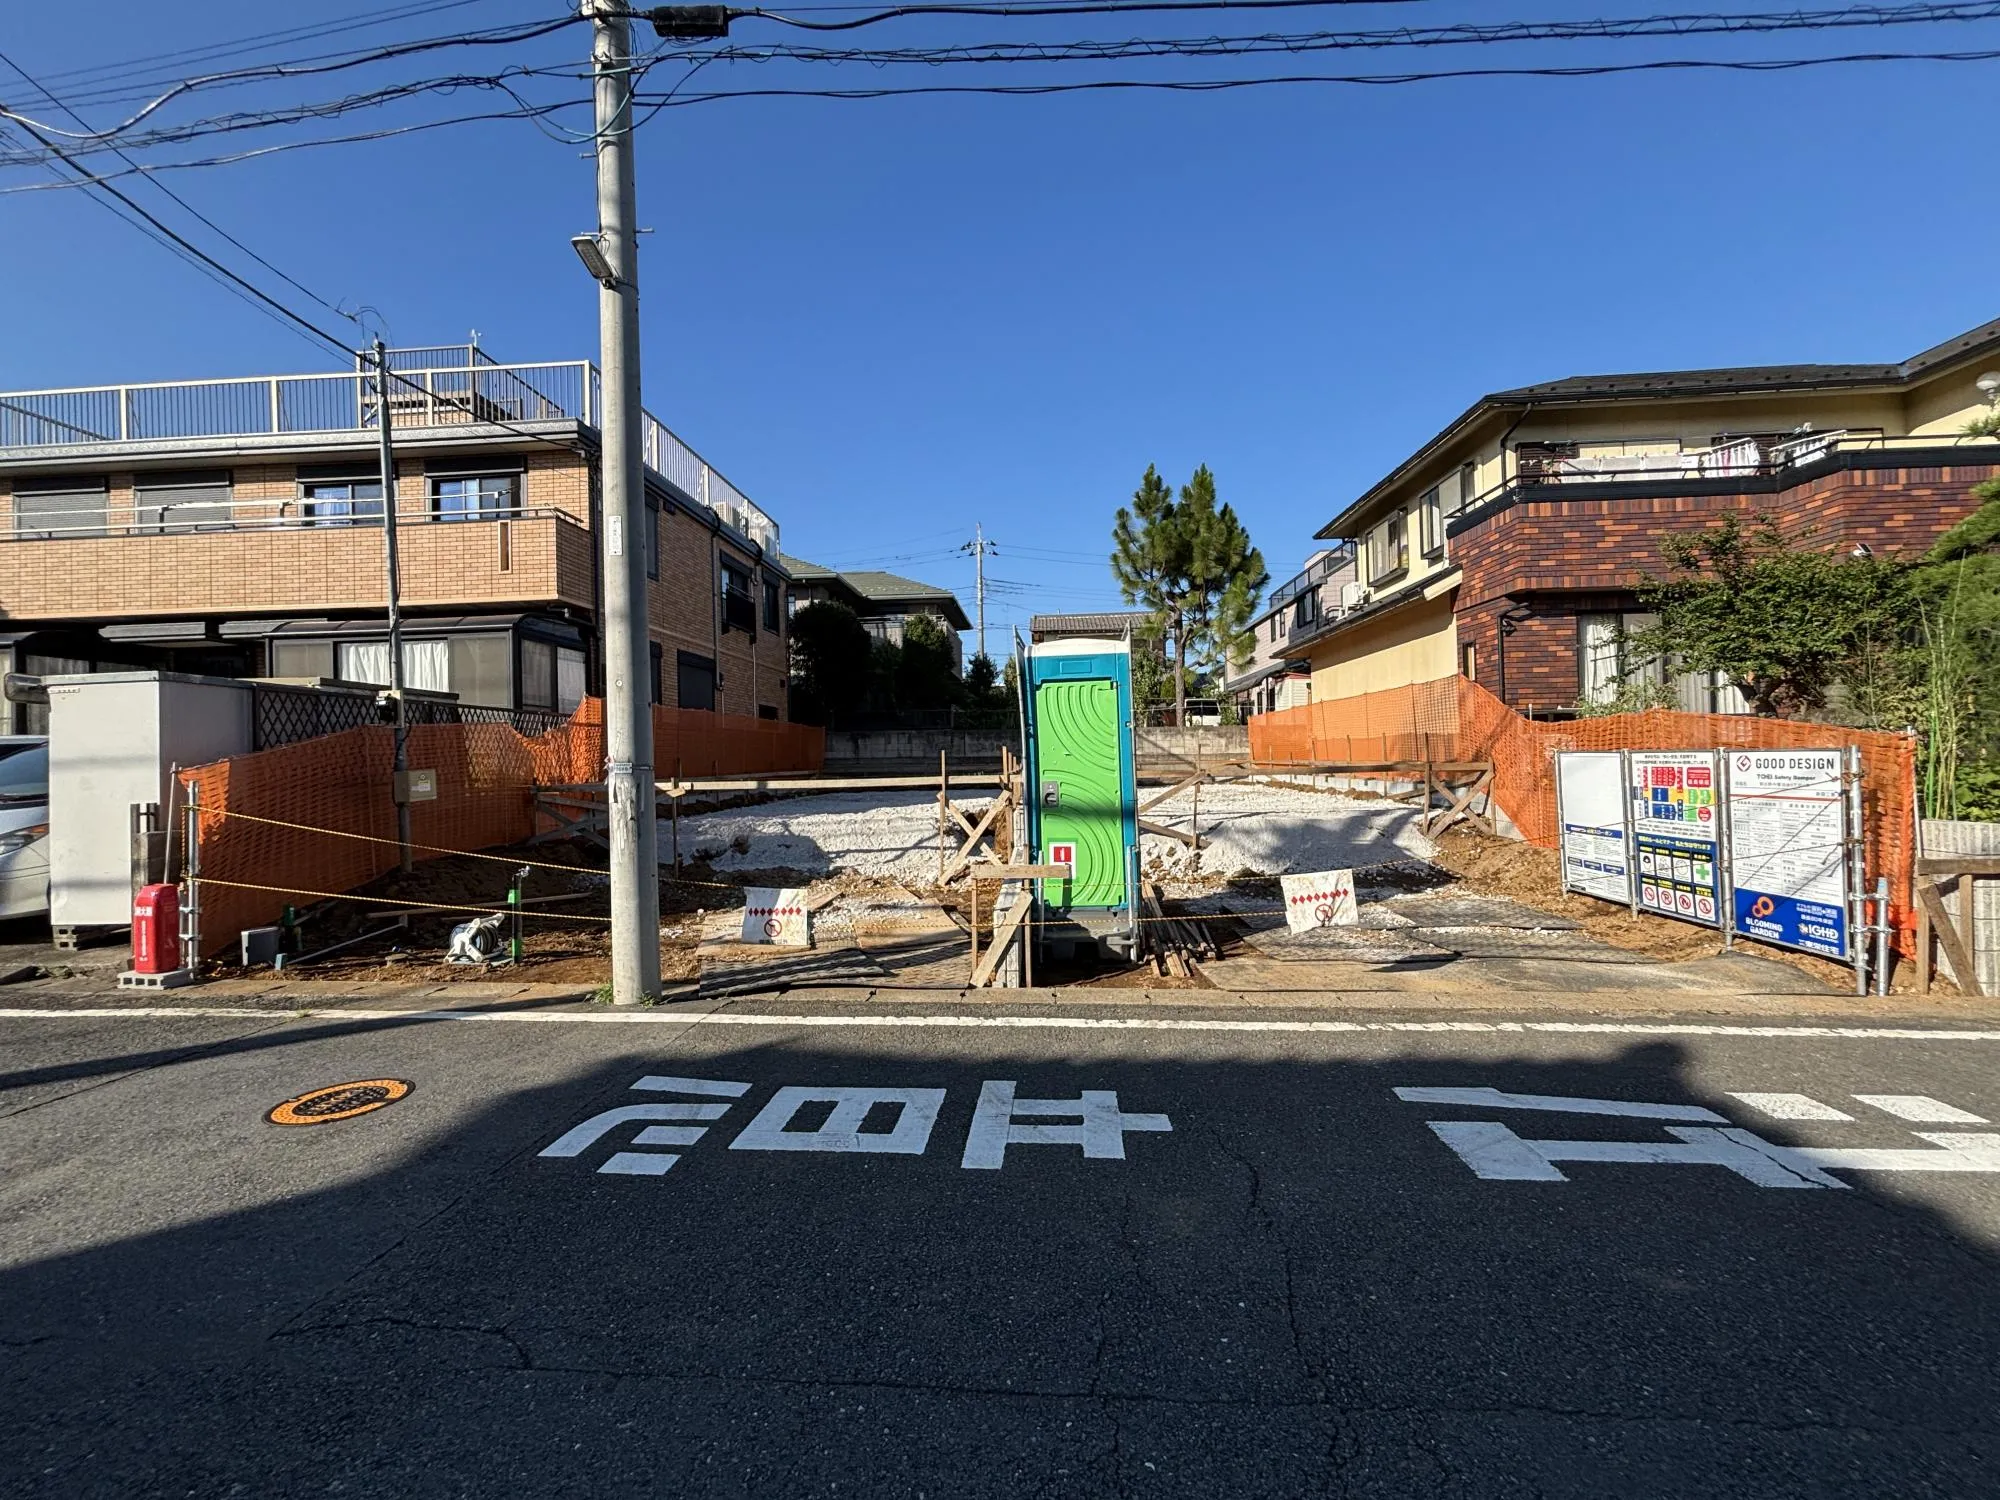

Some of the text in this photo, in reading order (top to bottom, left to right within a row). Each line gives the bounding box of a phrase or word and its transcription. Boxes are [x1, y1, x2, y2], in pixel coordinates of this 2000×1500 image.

[1755, 758, 1834, 770] GOOD DESIGN
[1745, 917, 1784, 932] BLOOMING
[1808, 924, 1839, 939] IGHD
[1749, 926, 1779, 939] GARDEN
